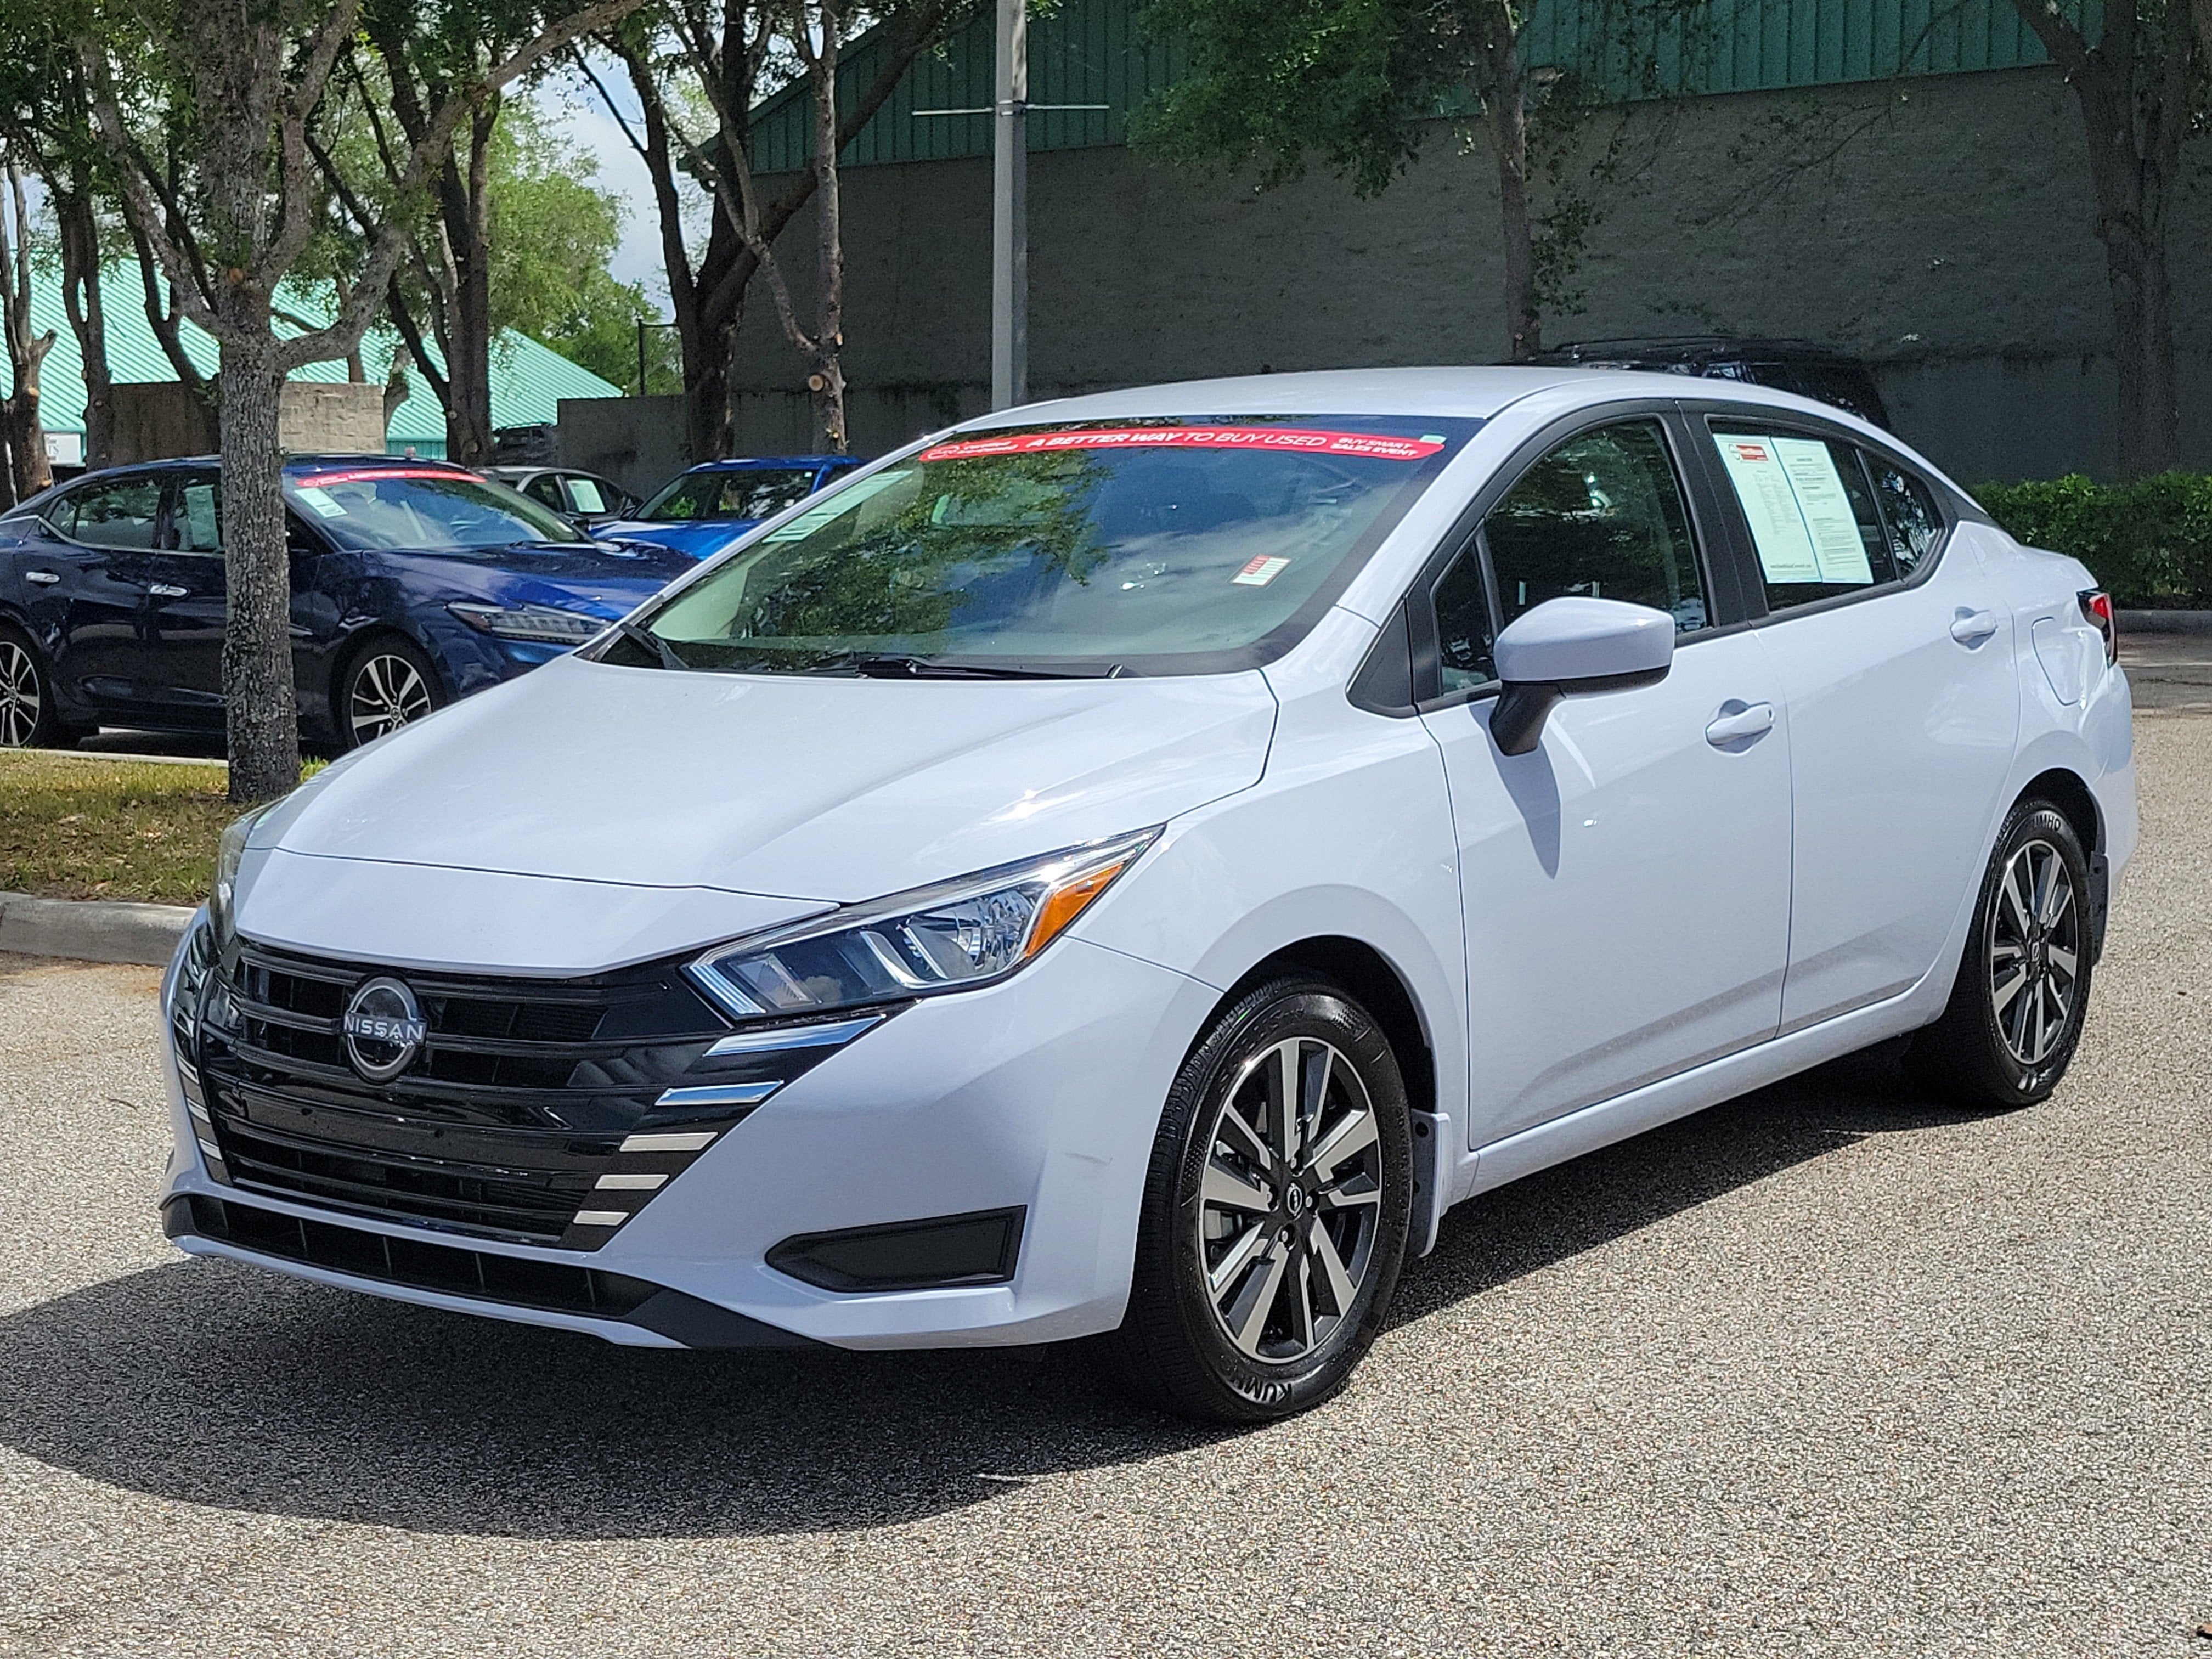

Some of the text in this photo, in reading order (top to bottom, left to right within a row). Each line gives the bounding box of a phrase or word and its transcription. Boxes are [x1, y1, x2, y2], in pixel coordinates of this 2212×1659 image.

[1025, 432, 1327, 448] A BETTER WAY TO BUY USED
[1339, 437, 1413, 449] BUY SMART
[1330, 443, 1419, 456] SALES EVENT
[2028, 814, 2061, 831] UMHO
[343, 1015, 424, 1040] NISSAN
